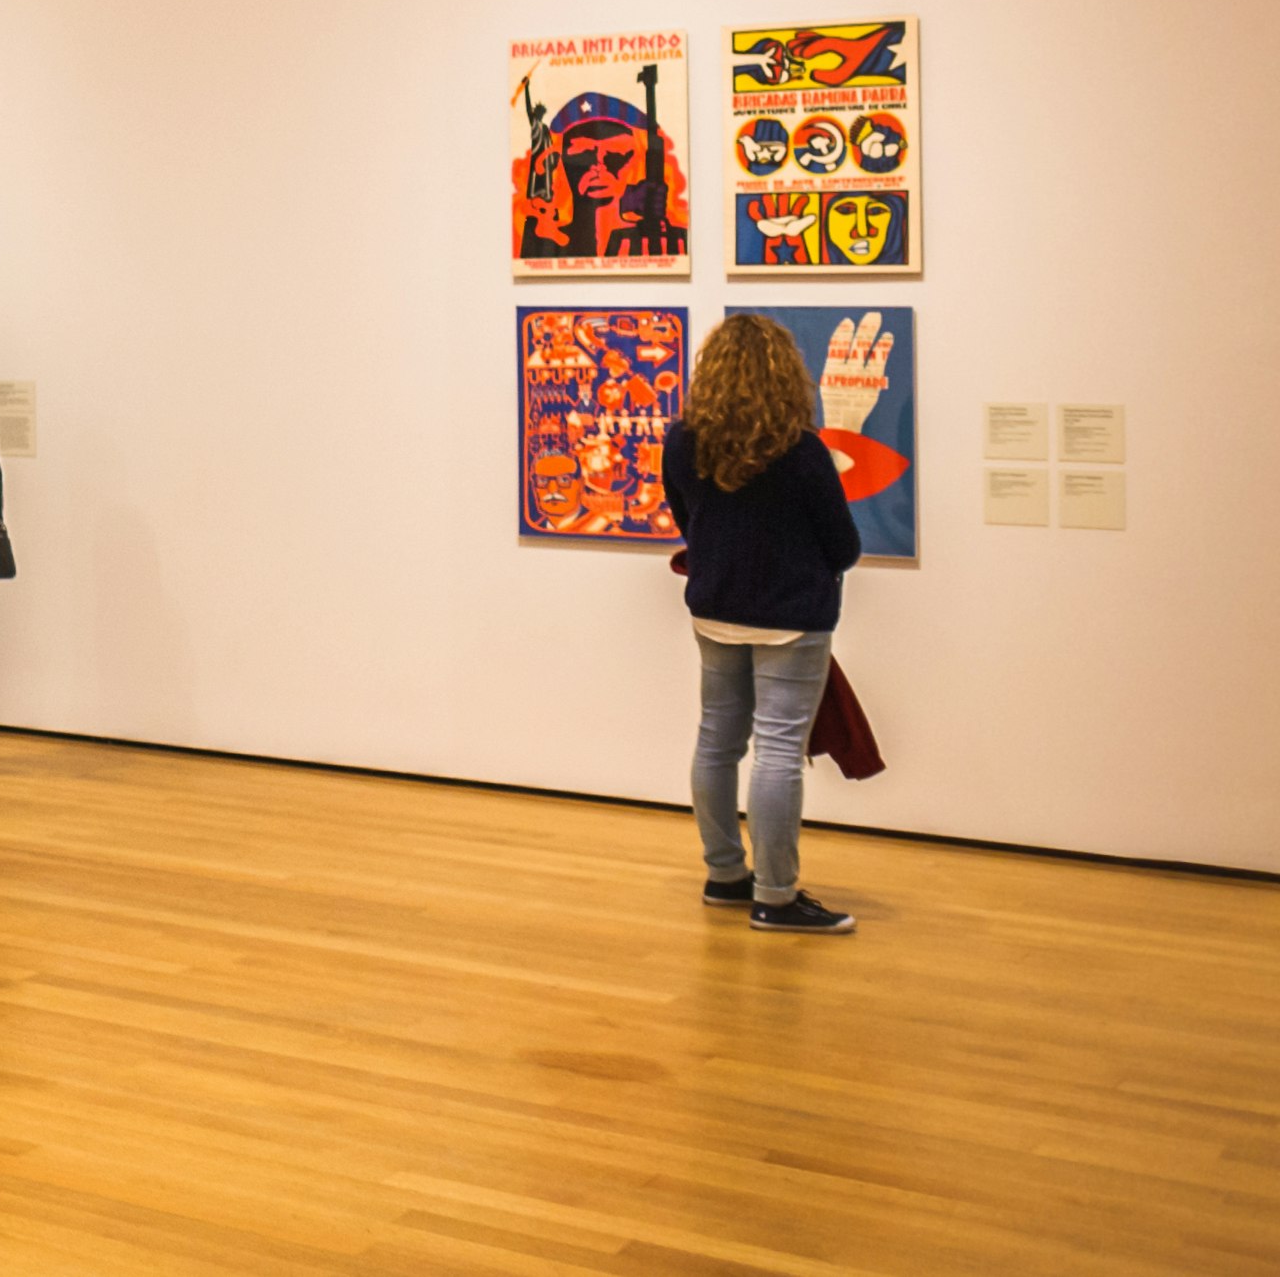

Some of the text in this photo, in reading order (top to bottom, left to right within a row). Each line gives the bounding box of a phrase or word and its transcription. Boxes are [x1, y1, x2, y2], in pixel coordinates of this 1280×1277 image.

[511, 33, 681, 59] BRIGADA INTI PEREDO
[548, 50, 608, 67] JUVENTUD
[732, 86, 908, 110] BRIGADAS RAMONA PARRA
